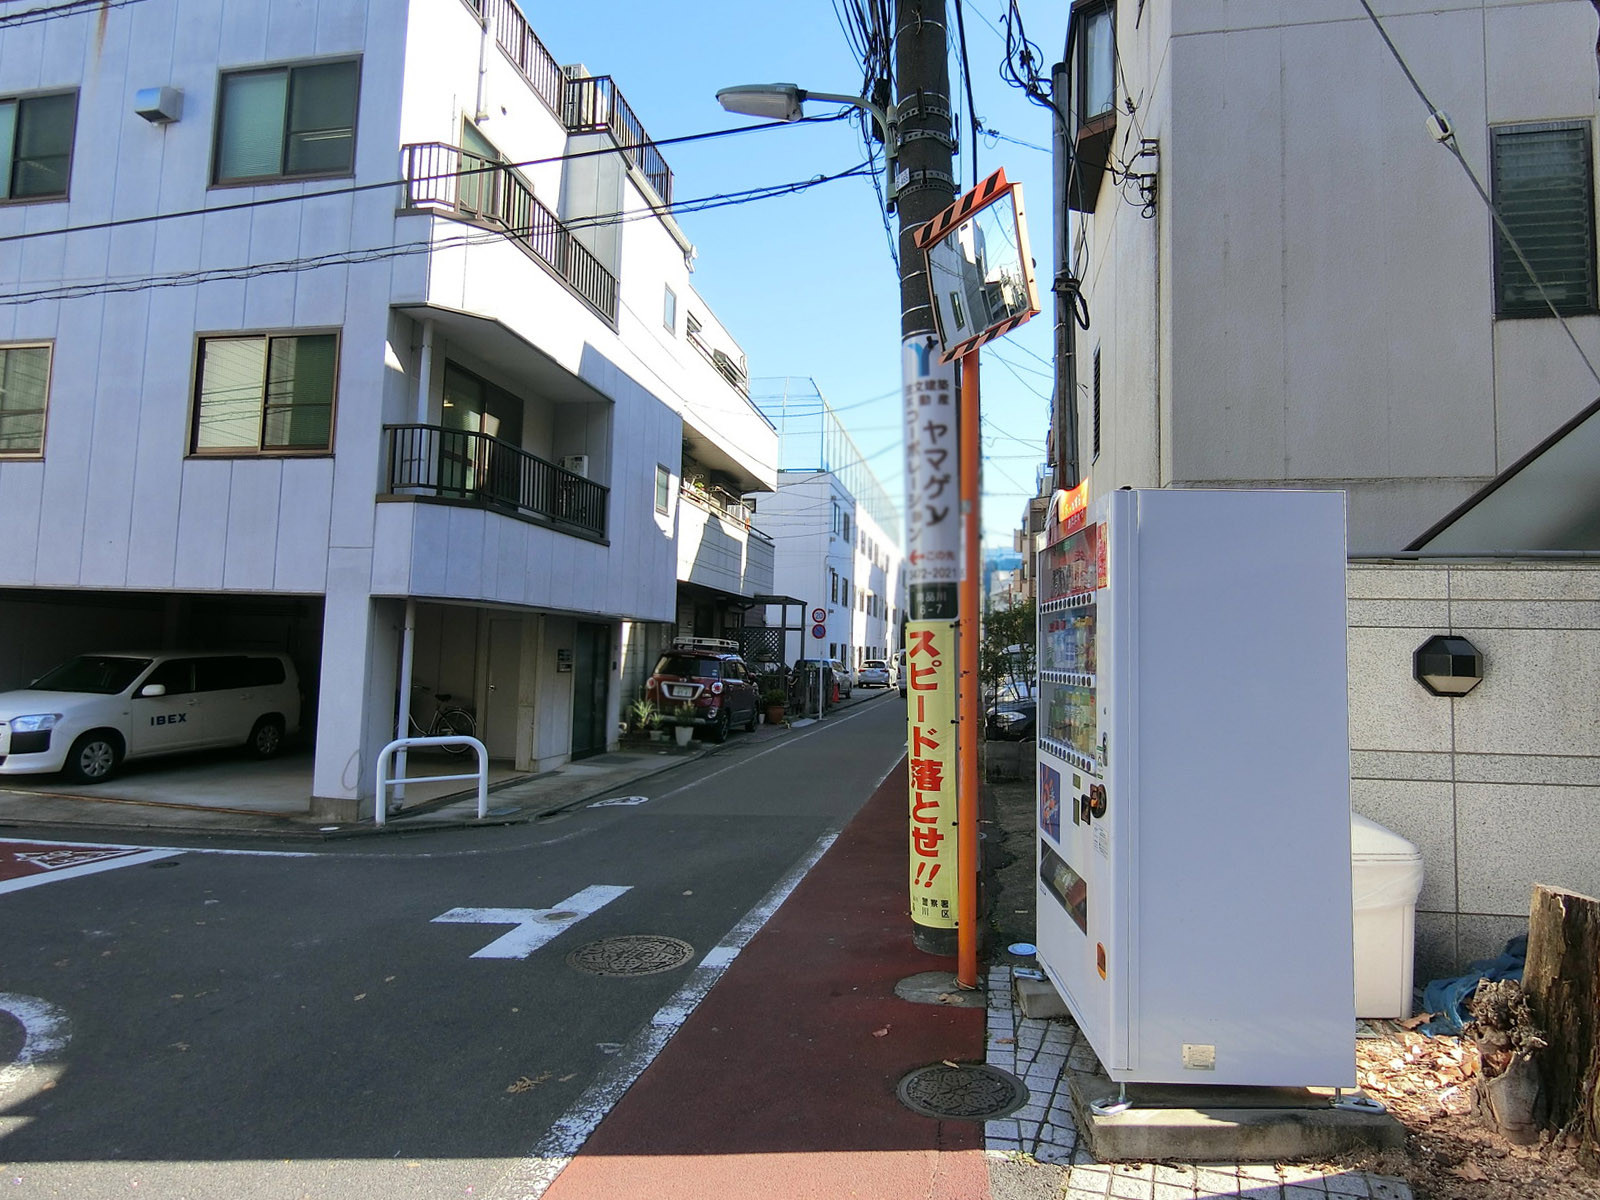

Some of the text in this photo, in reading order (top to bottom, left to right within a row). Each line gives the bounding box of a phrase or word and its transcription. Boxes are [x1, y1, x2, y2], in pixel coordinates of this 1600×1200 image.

[923, 419, 951, 527] ヤマゲン
[150, 713, 187, 726] IBEX
